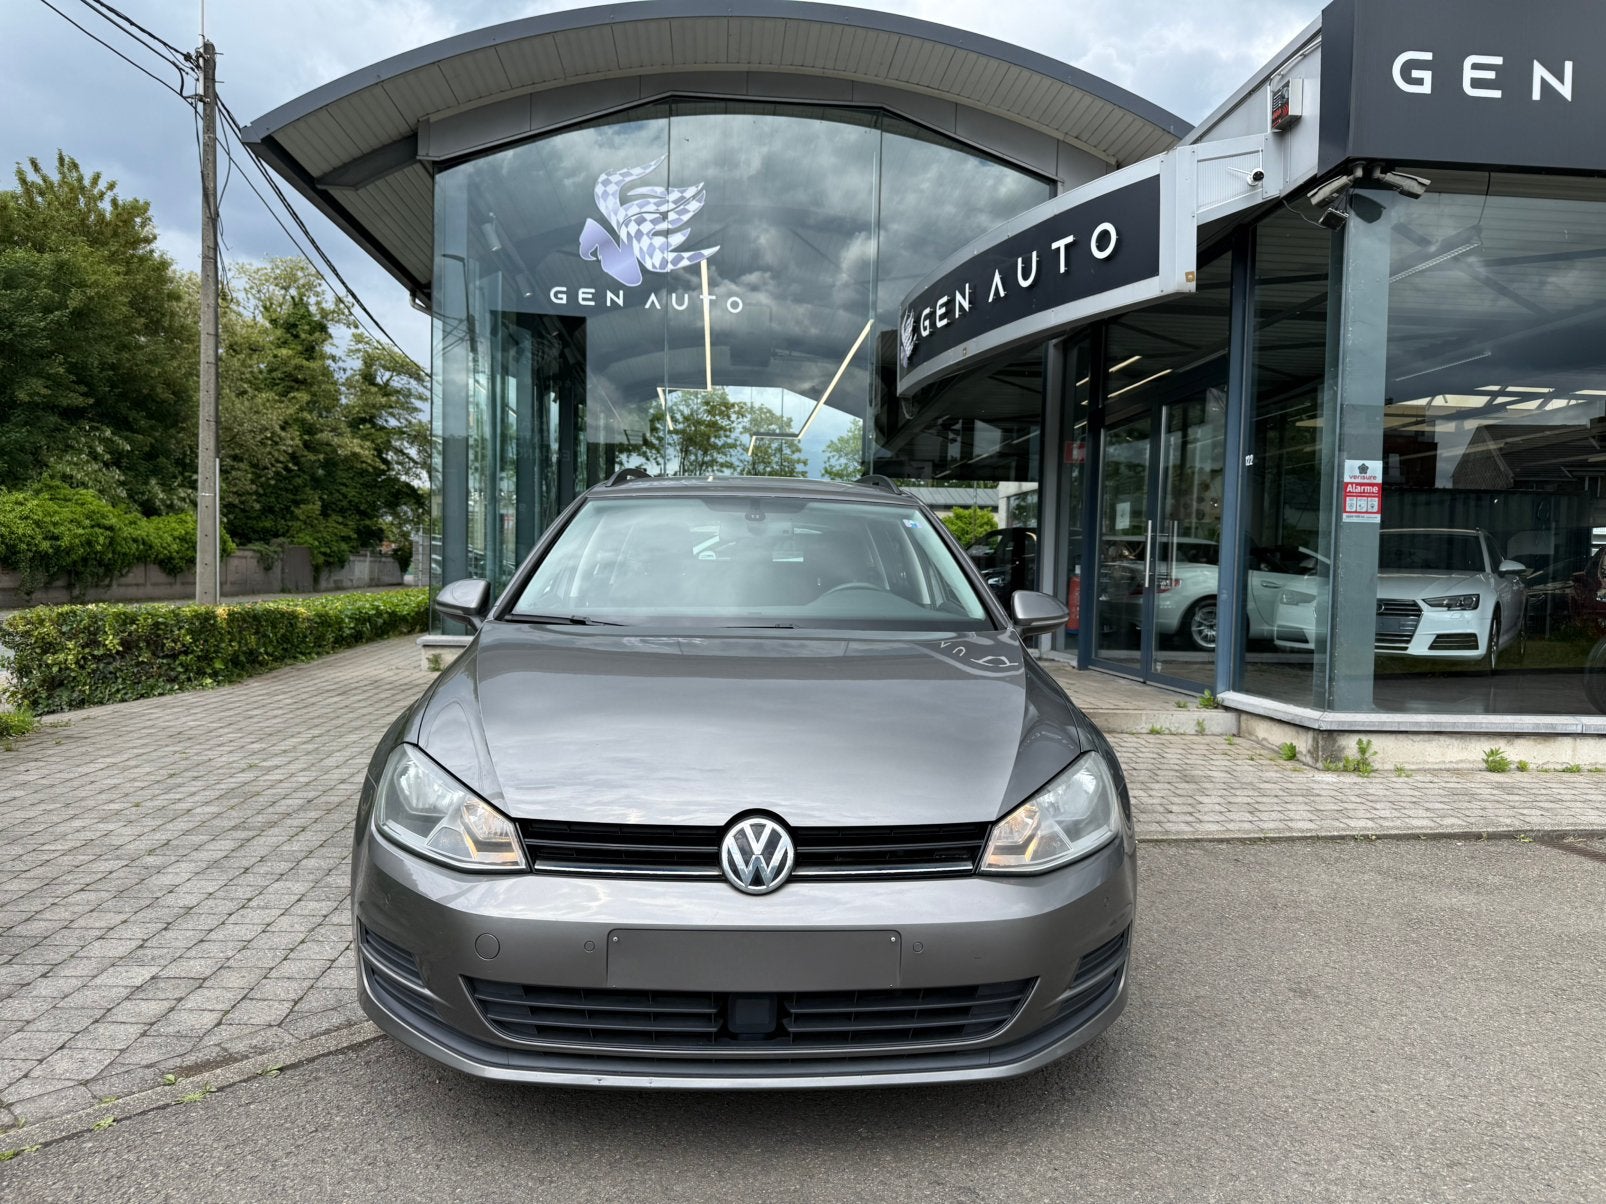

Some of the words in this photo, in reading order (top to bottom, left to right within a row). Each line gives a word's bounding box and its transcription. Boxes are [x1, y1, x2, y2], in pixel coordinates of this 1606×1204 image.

[1391, 50, 1573, 102] GEN
[919, 282, 971, 338] GEN
[988, 221, 1118, 303] AUTO
[549, 286, 624, 307] GEN
[644, 293, 743, 313] AUTO
[1346, 483, 1379, 493] Alarme
[1348, 473, 1378, 481] verisure
[723, 819, 793, 892] VW
